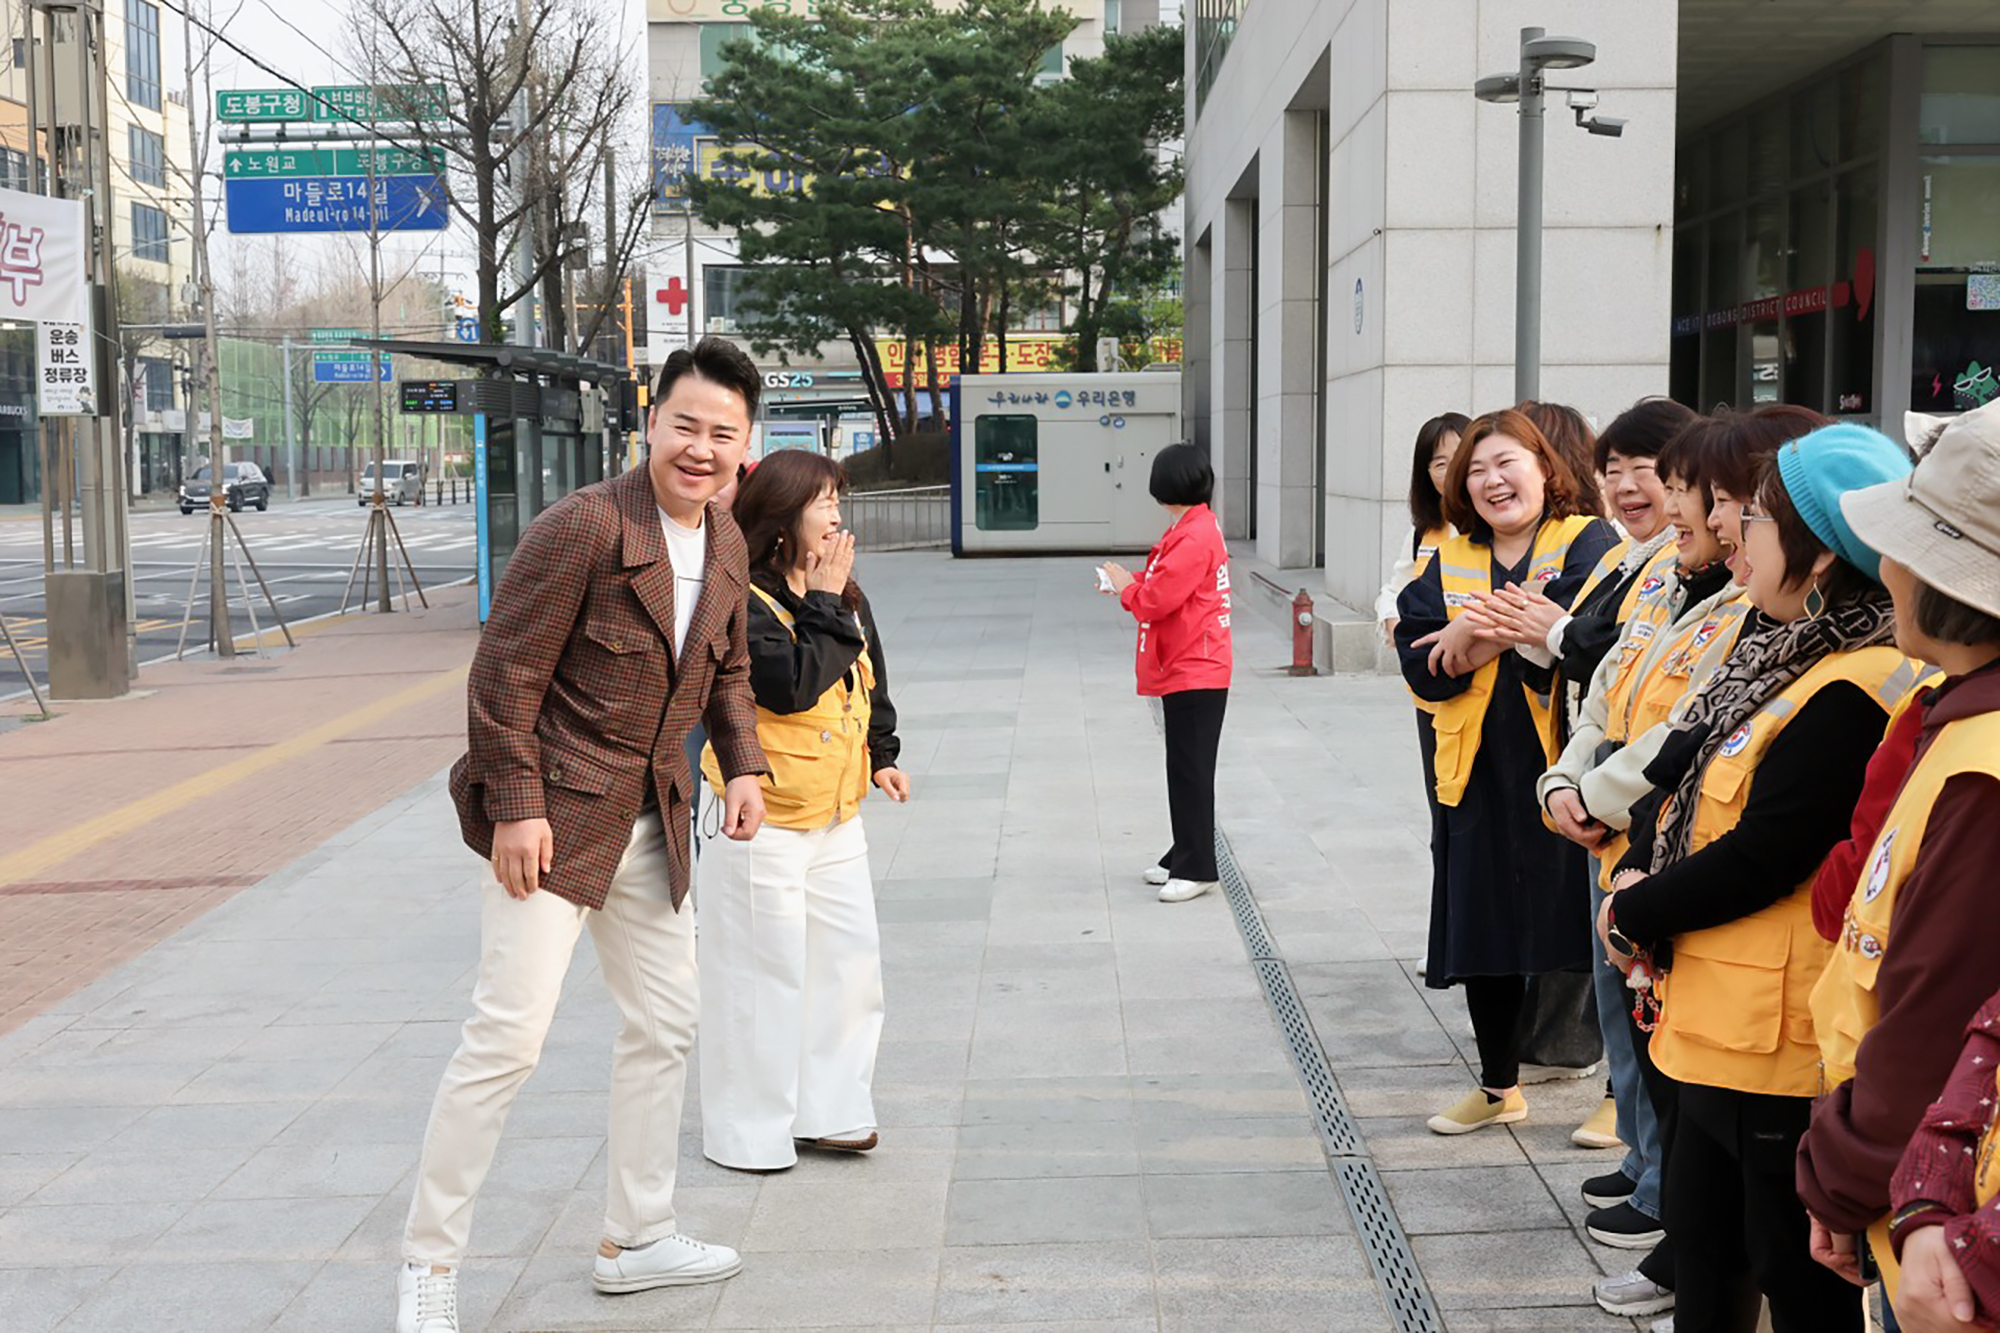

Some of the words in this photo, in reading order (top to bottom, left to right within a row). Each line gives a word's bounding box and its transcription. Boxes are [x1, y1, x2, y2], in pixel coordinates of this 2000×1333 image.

[225, 94, 300, 115] 도봉구청
[248, 155, 296, 173] 노원교
[284, 181, 388, 207] 마들로14길
[285, 207, 349, 224] Madeul-ro
[1785, 290, 1827, 312] COUNCIL
[50, 329, 79, 346] 운송
[51, 348, 79, 364] 버스
[44, 367, 88, 384] 정류장
[764, 372, 813, 388] GS25
[1077, 390, 1136, 407] 우리은행
